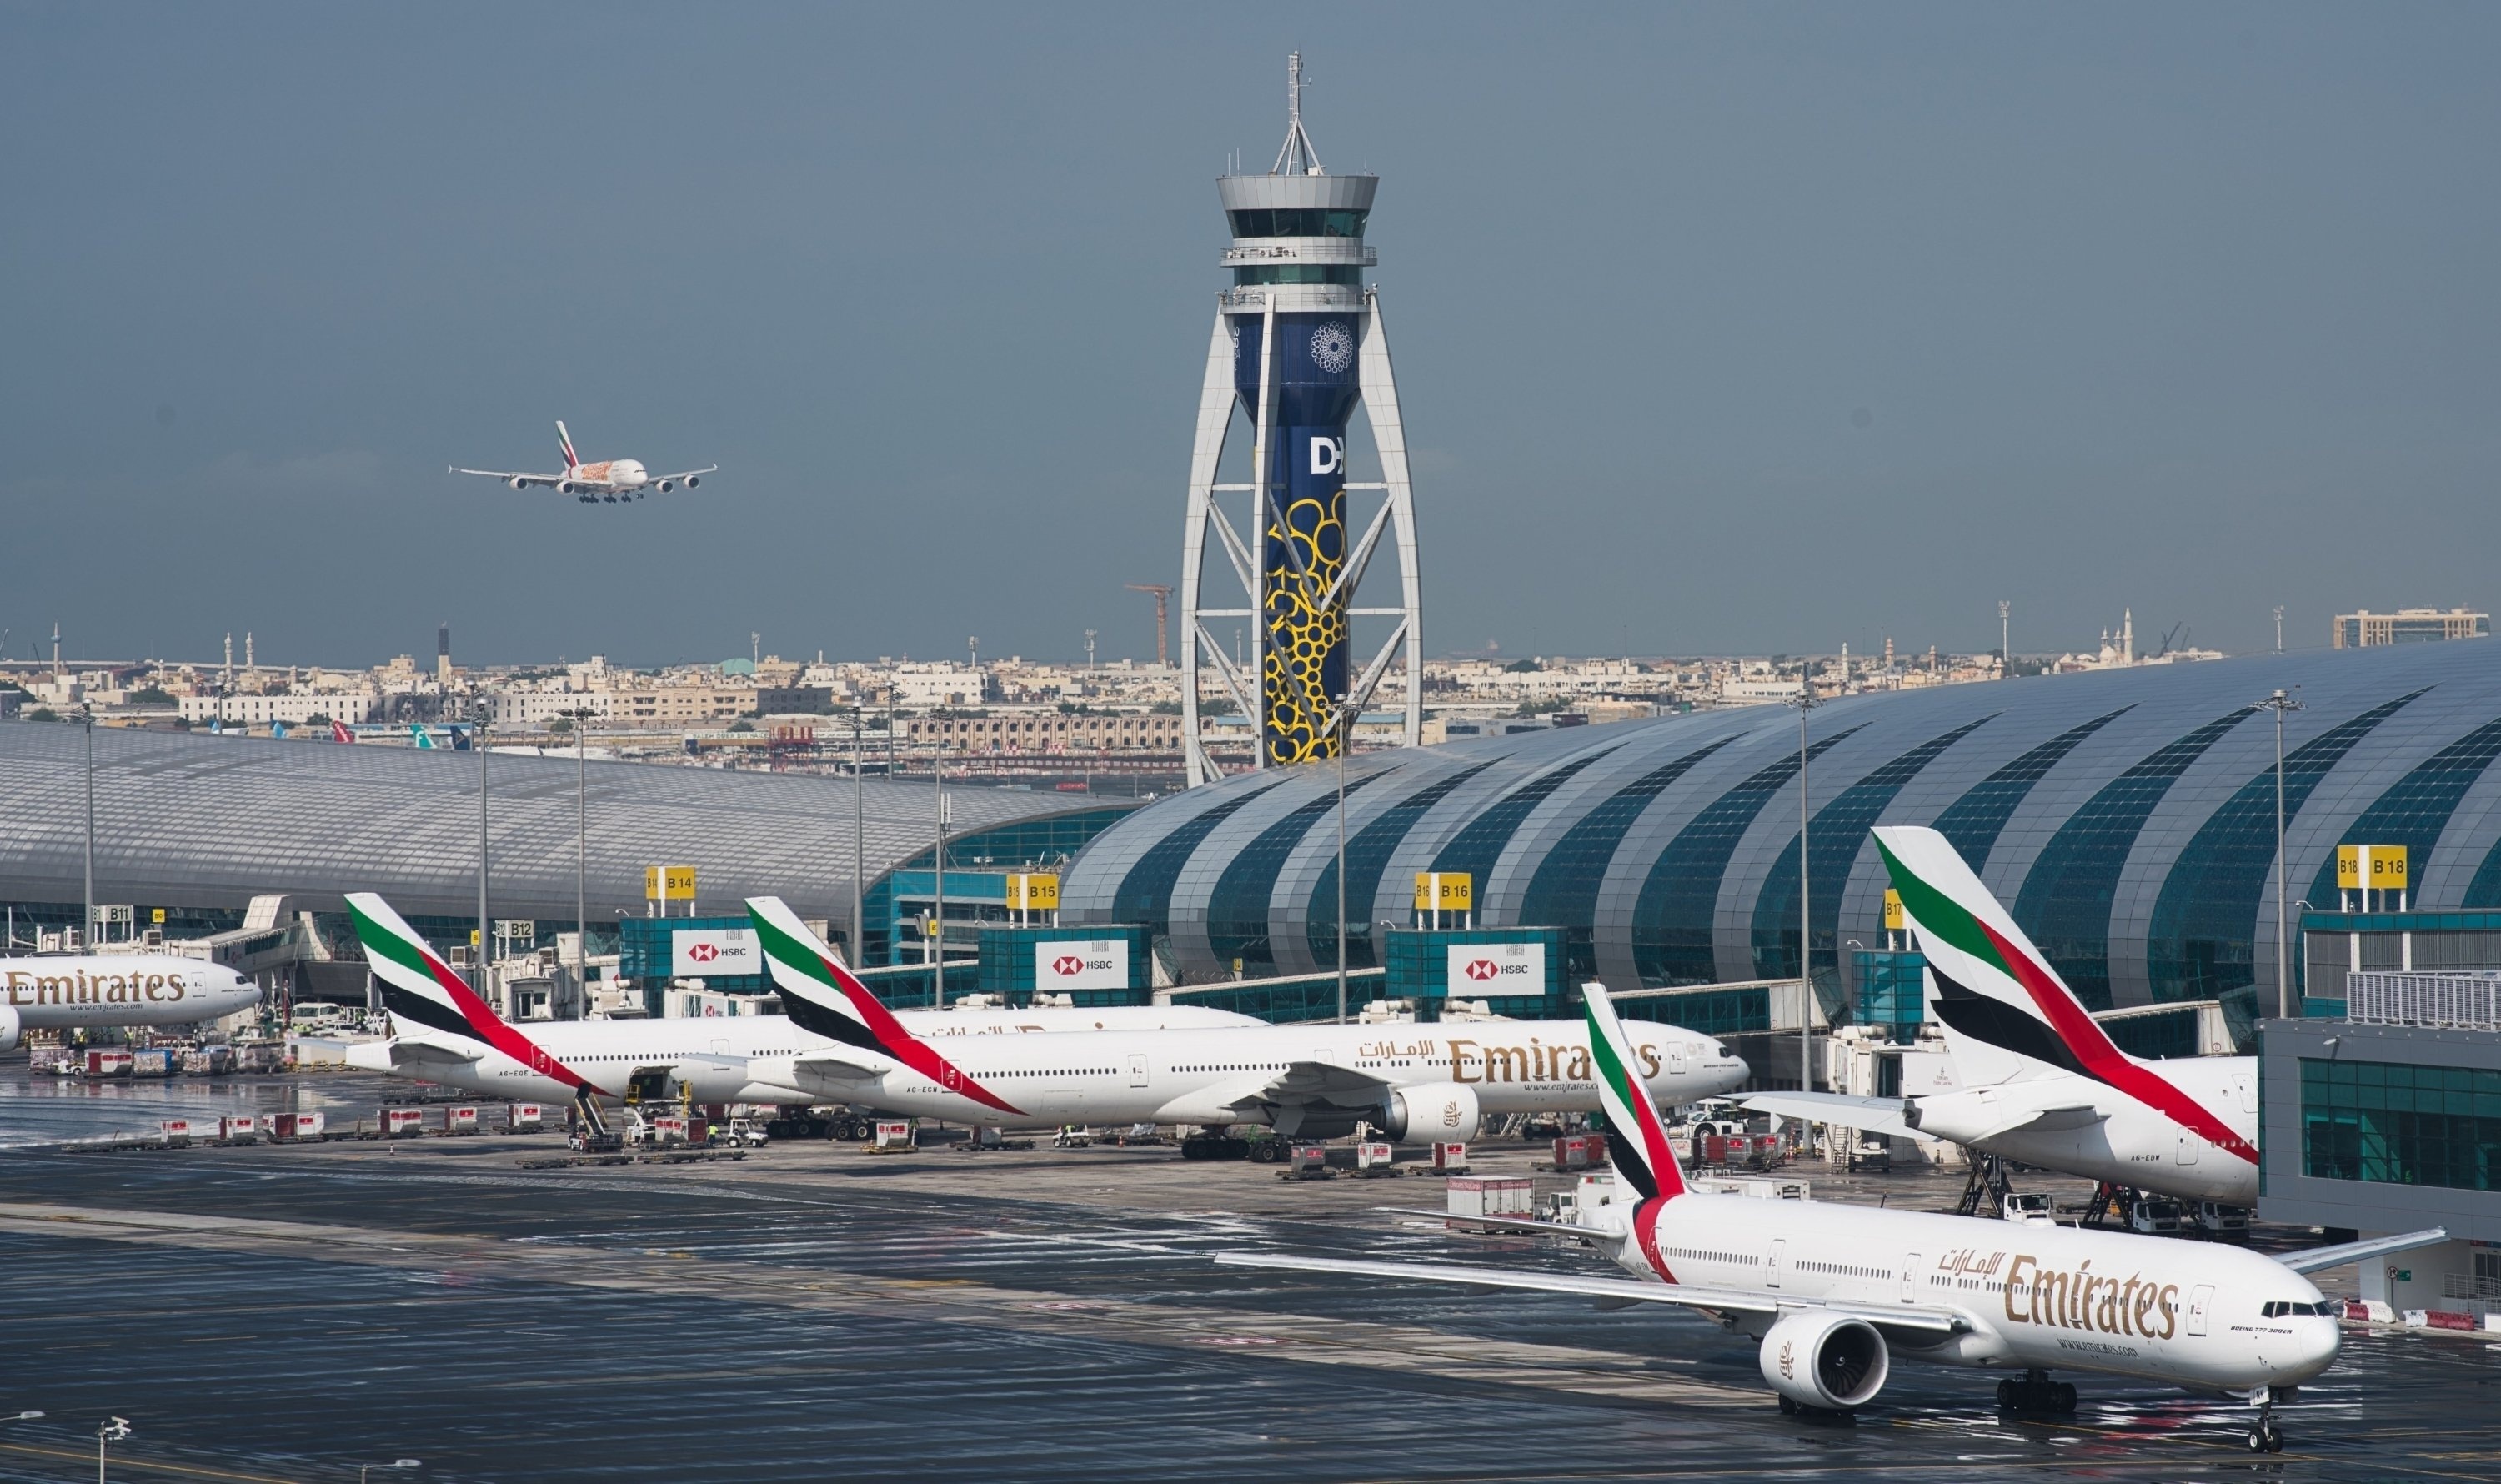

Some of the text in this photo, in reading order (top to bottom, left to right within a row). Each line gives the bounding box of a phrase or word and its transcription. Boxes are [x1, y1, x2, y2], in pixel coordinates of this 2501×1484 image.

[2340, 860, 2358, 874] B 18
[2374, 860, 2404, 874] B 18
[647, 878, 658, 888] B 14
[668, 878, 692, 888] B 14
[1008, 886, 1020, 898] B 15
[1030, 886, 1055, 898] B 15
[1417, 885, 1430, 897] B 16
[1441, 885, 1468, 897] B 16
[110, 907, 128, 920] B11
[1887, 903, 1902, 916] B 17
[511, 923, 531, 935] B12
[721, 948, 747, 956] HSBC
[1086, 960, 1113, 970] HSBC
[1501, 965, 1529, 975] HSBC
[4, 968, 186, 1005] Emirates
[69, 1001, 143, 1013] www.emirates.com
[1359, 1040, 1435, 1060] الإمارات
[1446, 1037, 1661, 1084] Emiras
[1937, 1248, 2007, 1280] الإمارات
[2004, 1254, 2179, 1341] Emirates
[2057, 1336, 2140, 1359] www.emirates.com
